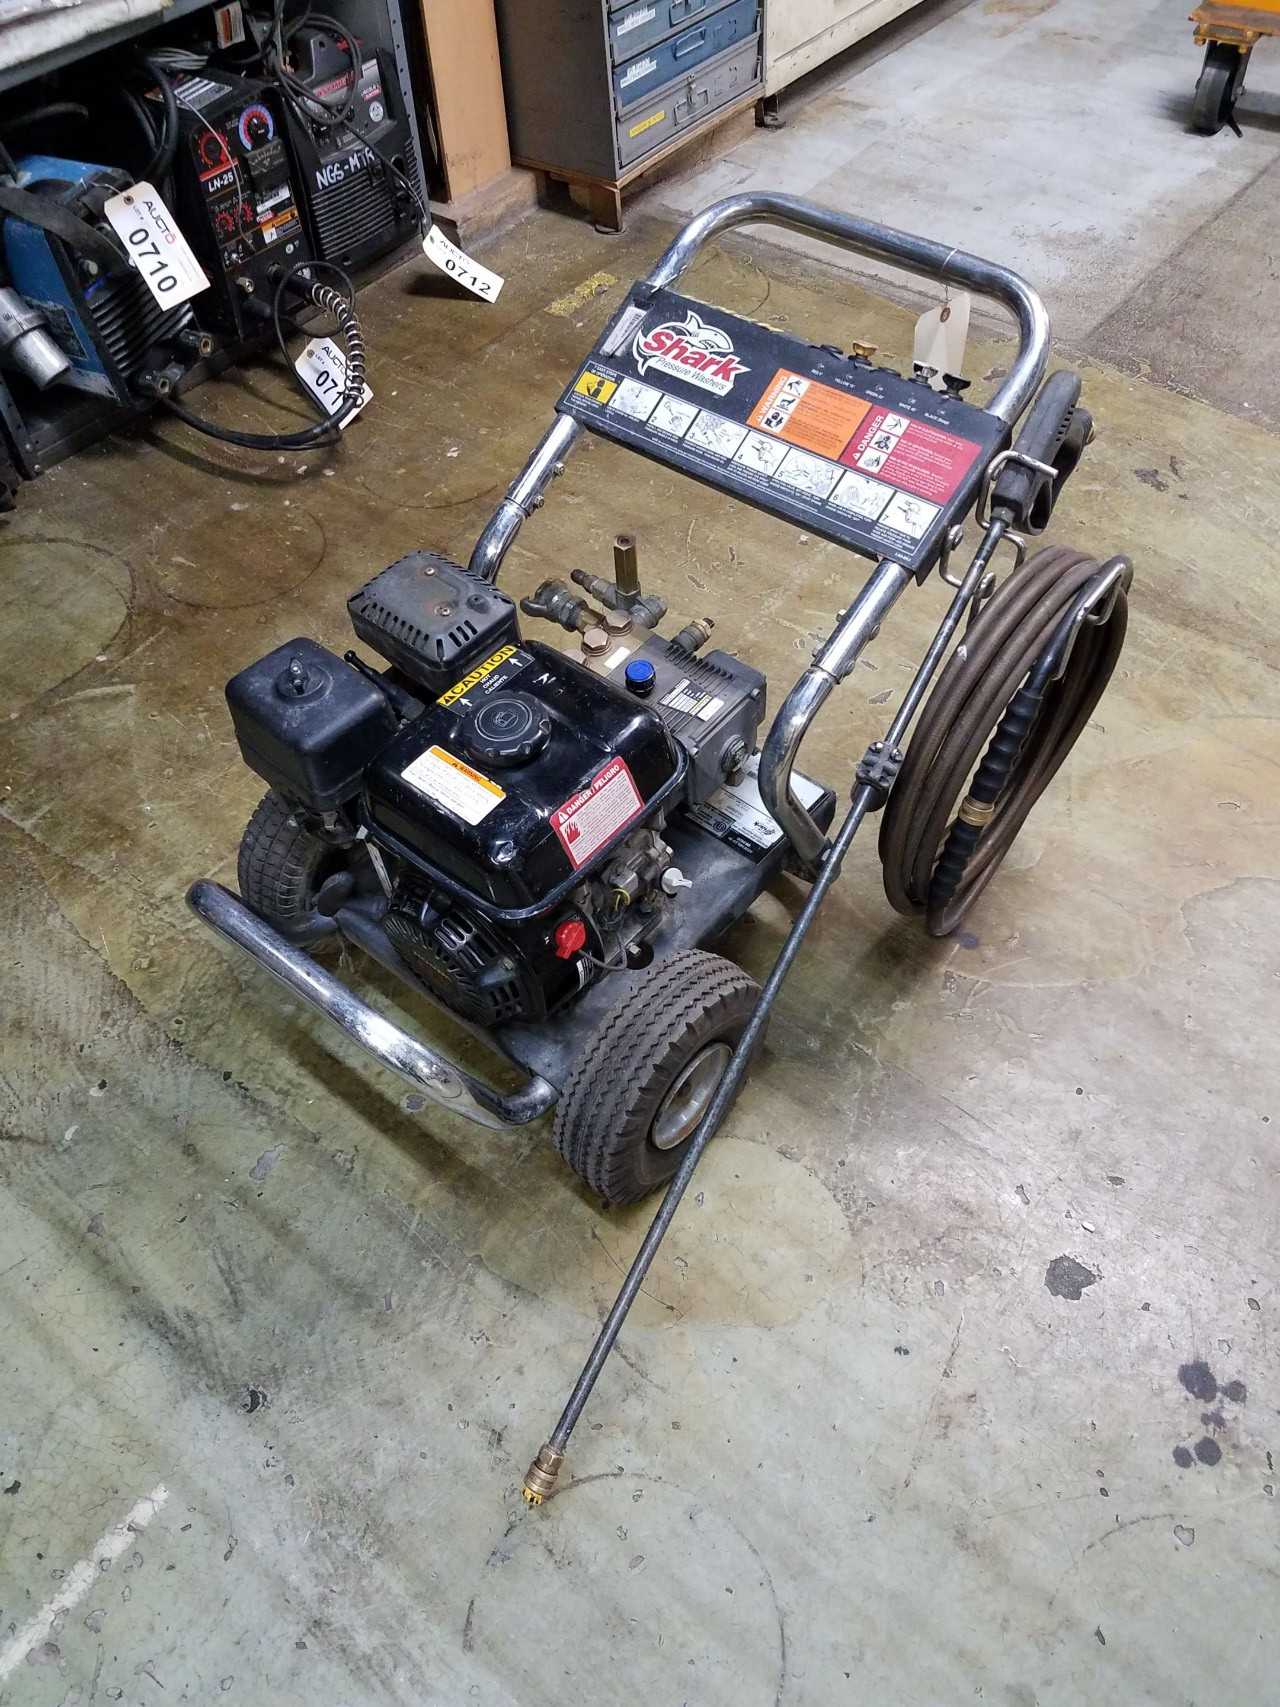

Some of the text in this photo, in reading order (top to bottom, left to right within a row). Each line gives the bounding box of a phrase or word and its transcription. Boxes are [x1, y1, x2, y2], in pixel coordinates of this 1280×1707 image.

[128, 228, 178, 292] 0710
[445, 259, 492, 296] 0712
[643, 331, 742, 382] Shark
[655, 358, 727, 391] Pressure Washers
[315, 370, 346, 406] 071
[760, 376, 787, 417] WARNING
[858, 415, 884, 451] DANGER
[451, 647, 513, 695] CAUTION
[567, 791, 592, 815] DANGER
[594, 765, 620, 790] PELIGRO
